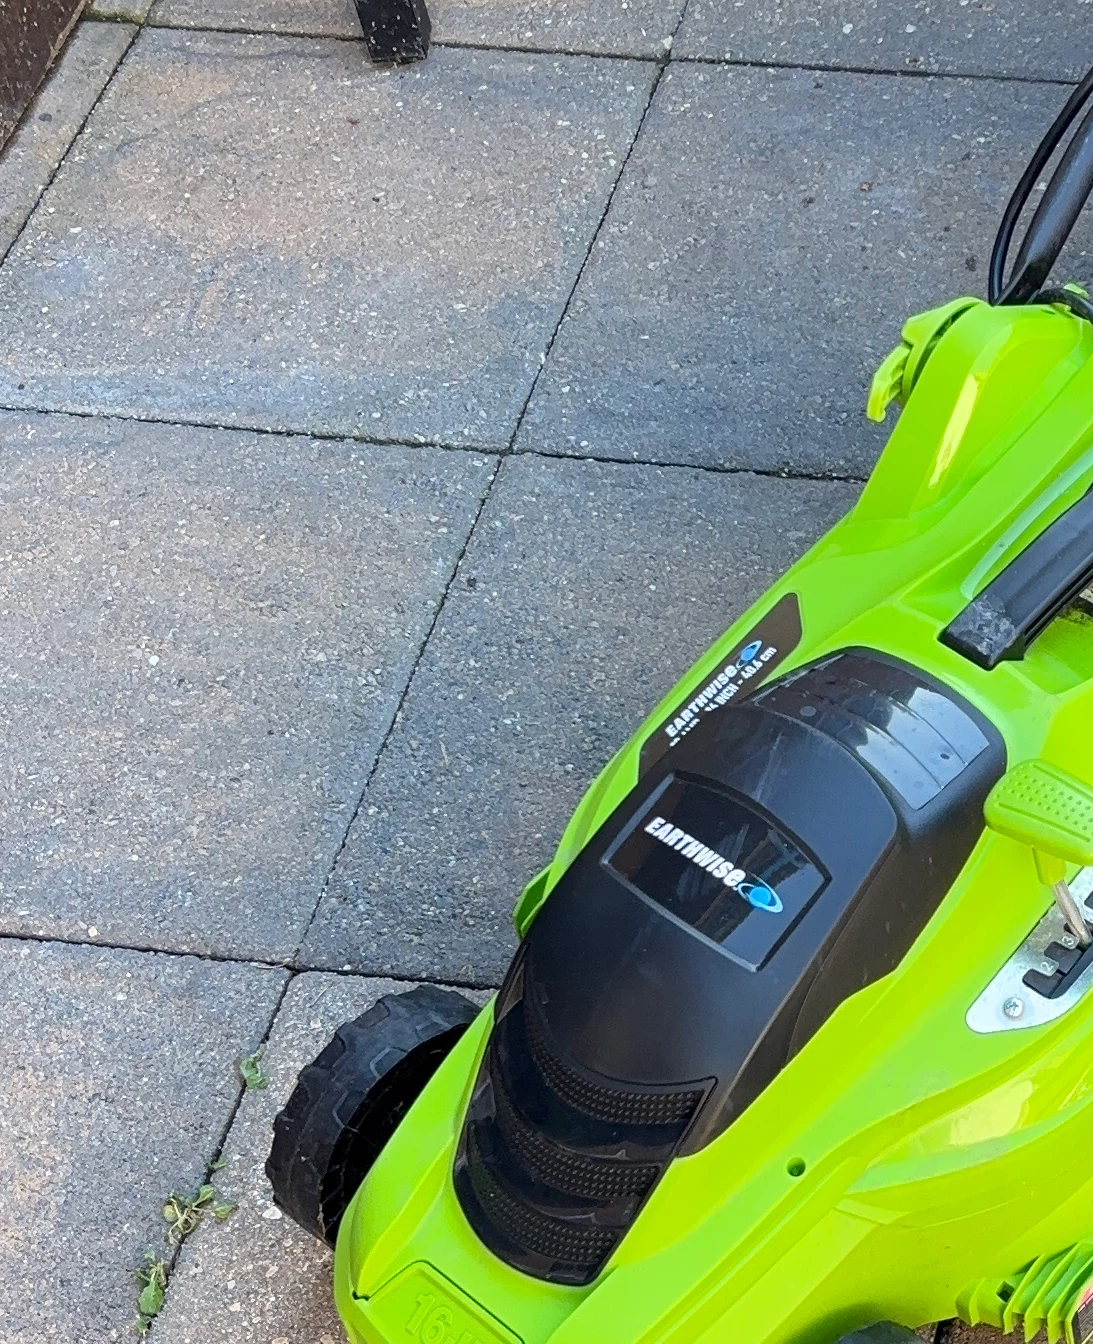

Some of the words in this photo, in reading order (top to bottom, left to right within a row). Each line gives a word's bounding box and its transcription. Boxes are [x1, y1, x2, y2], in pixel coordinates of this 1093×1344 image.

[760, 647, 777, 662] cm
[1039, 959, 1054, 973] 2
[1061, 933, 1075, 947] 3
